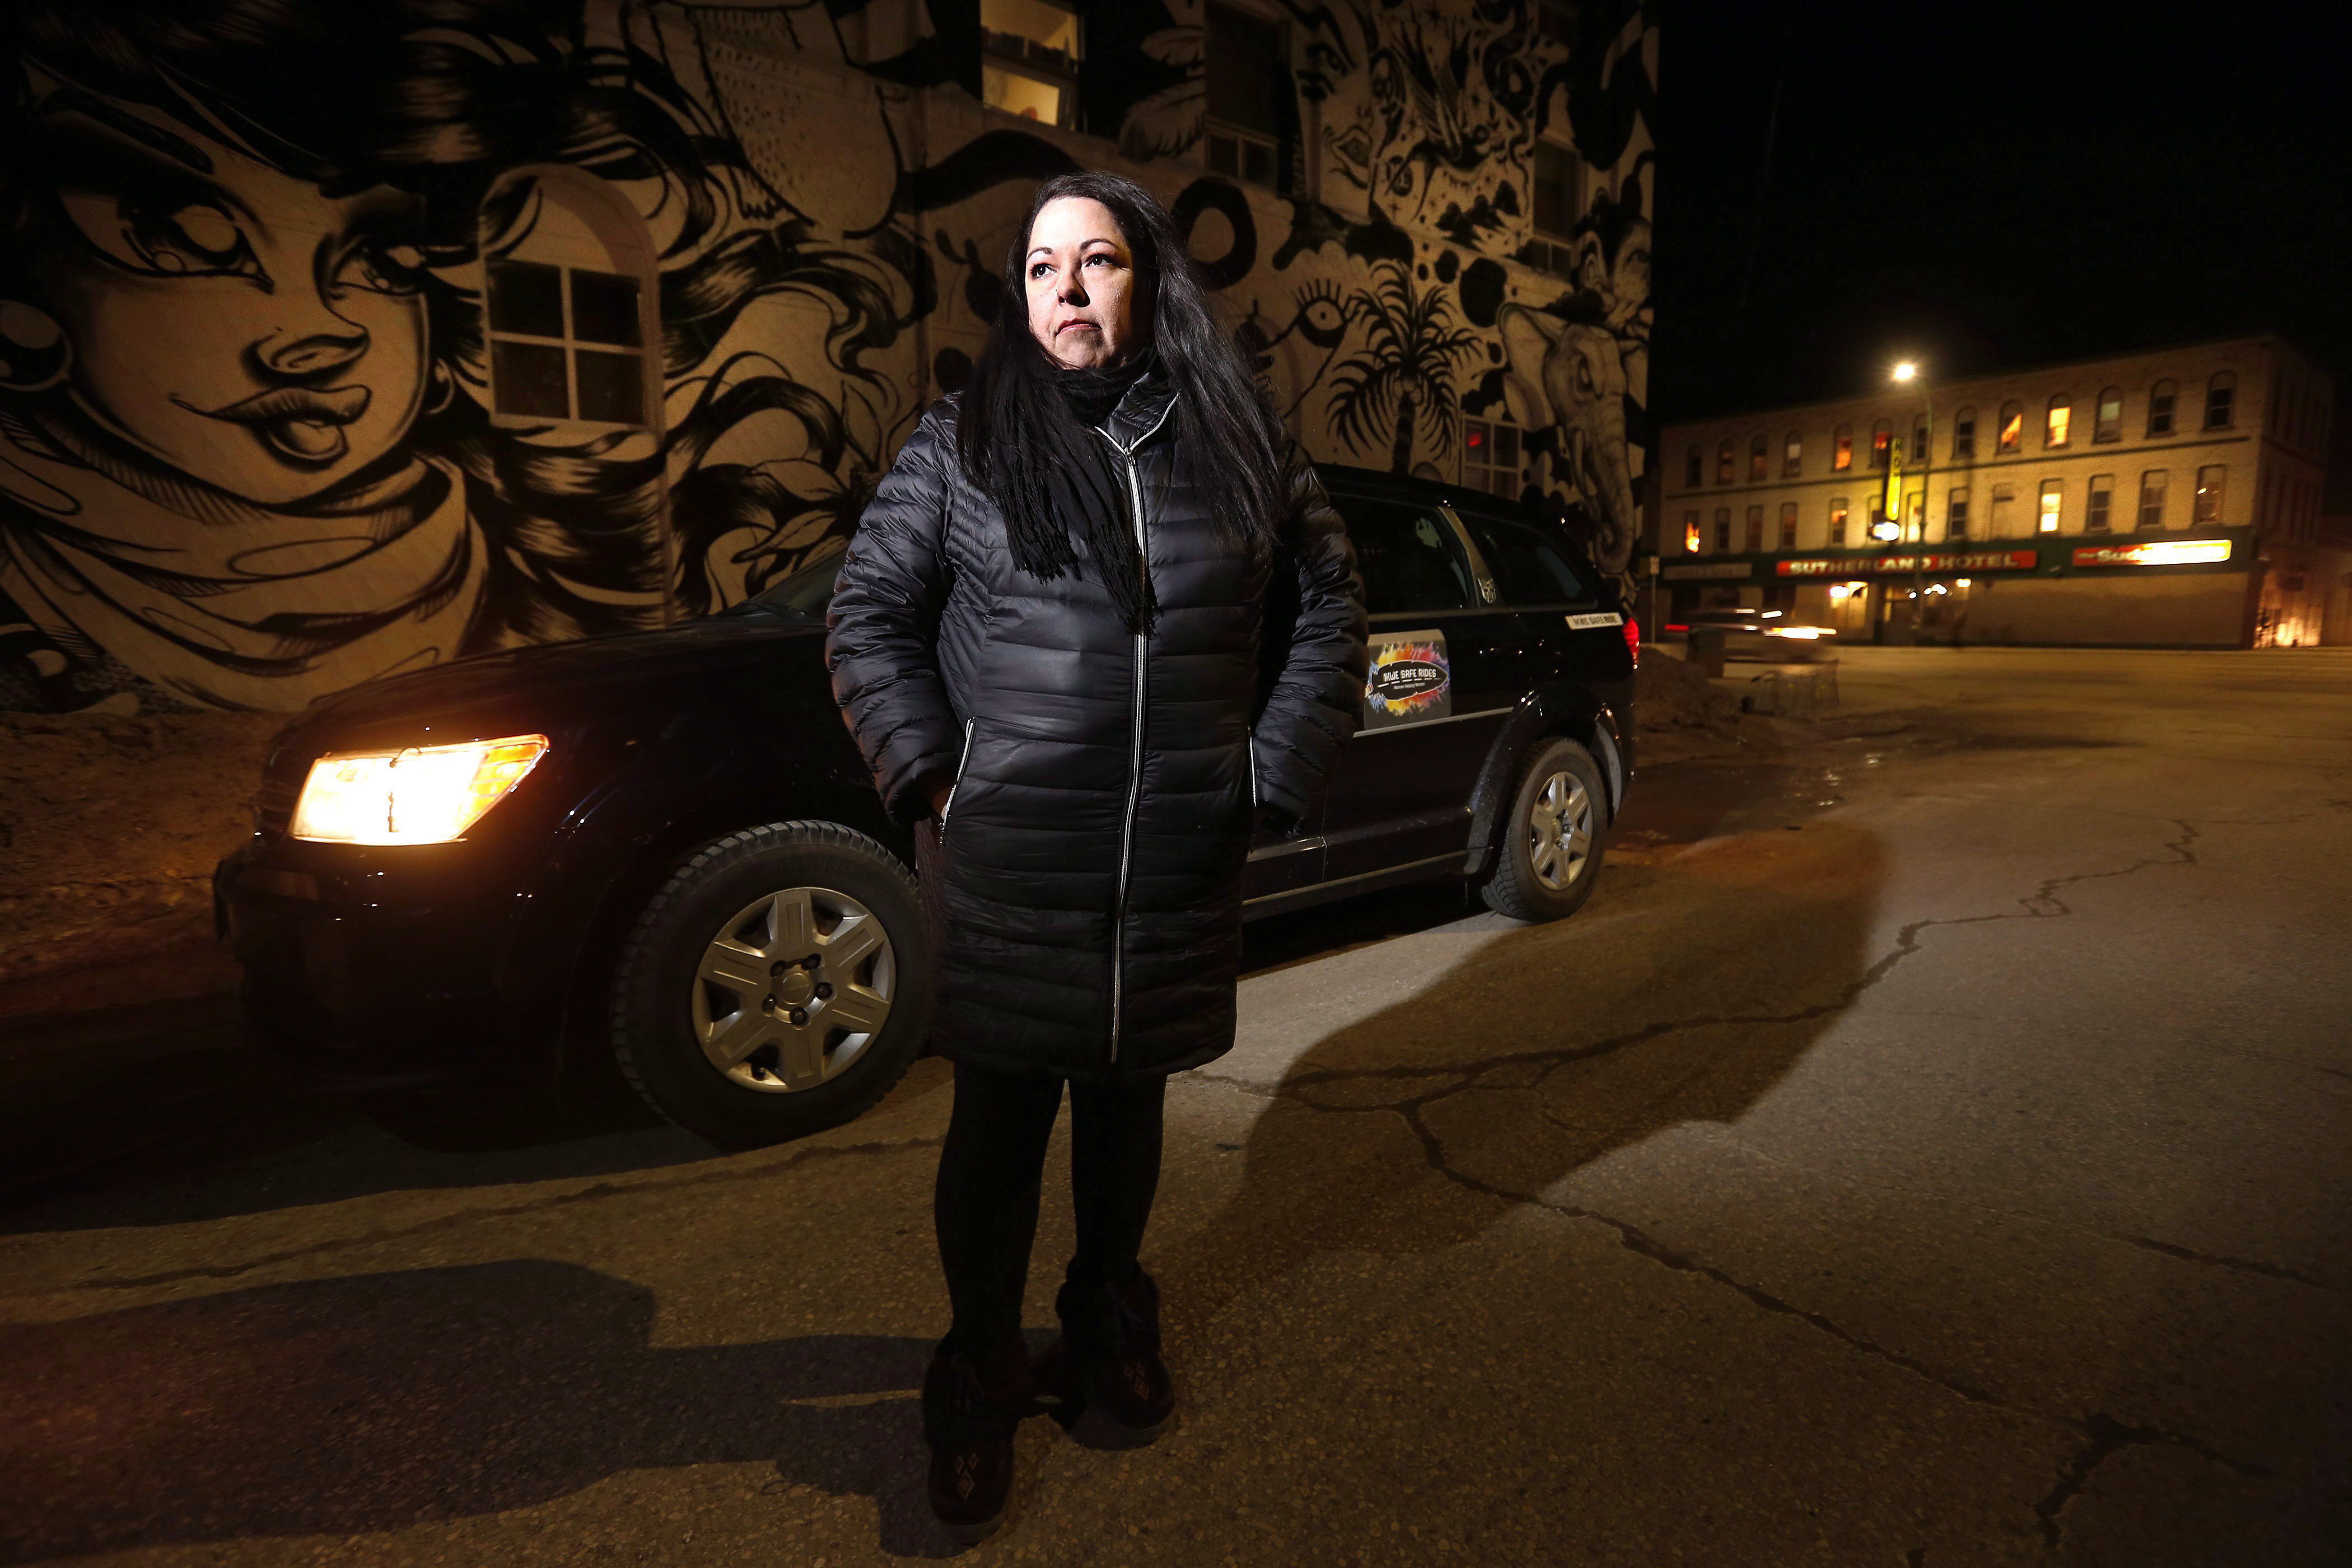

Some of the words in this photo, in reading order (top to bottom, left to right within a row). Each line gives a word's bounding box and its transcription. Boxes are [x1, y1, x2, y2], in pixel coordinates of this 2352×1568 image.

[1938, 554, 2018, 570] HOTEL
[1384, 671, 1399, 682] IKWE
[1401, 669, 1417, 679] SAFE
[1418, 668, 1436, 678] RIDES
